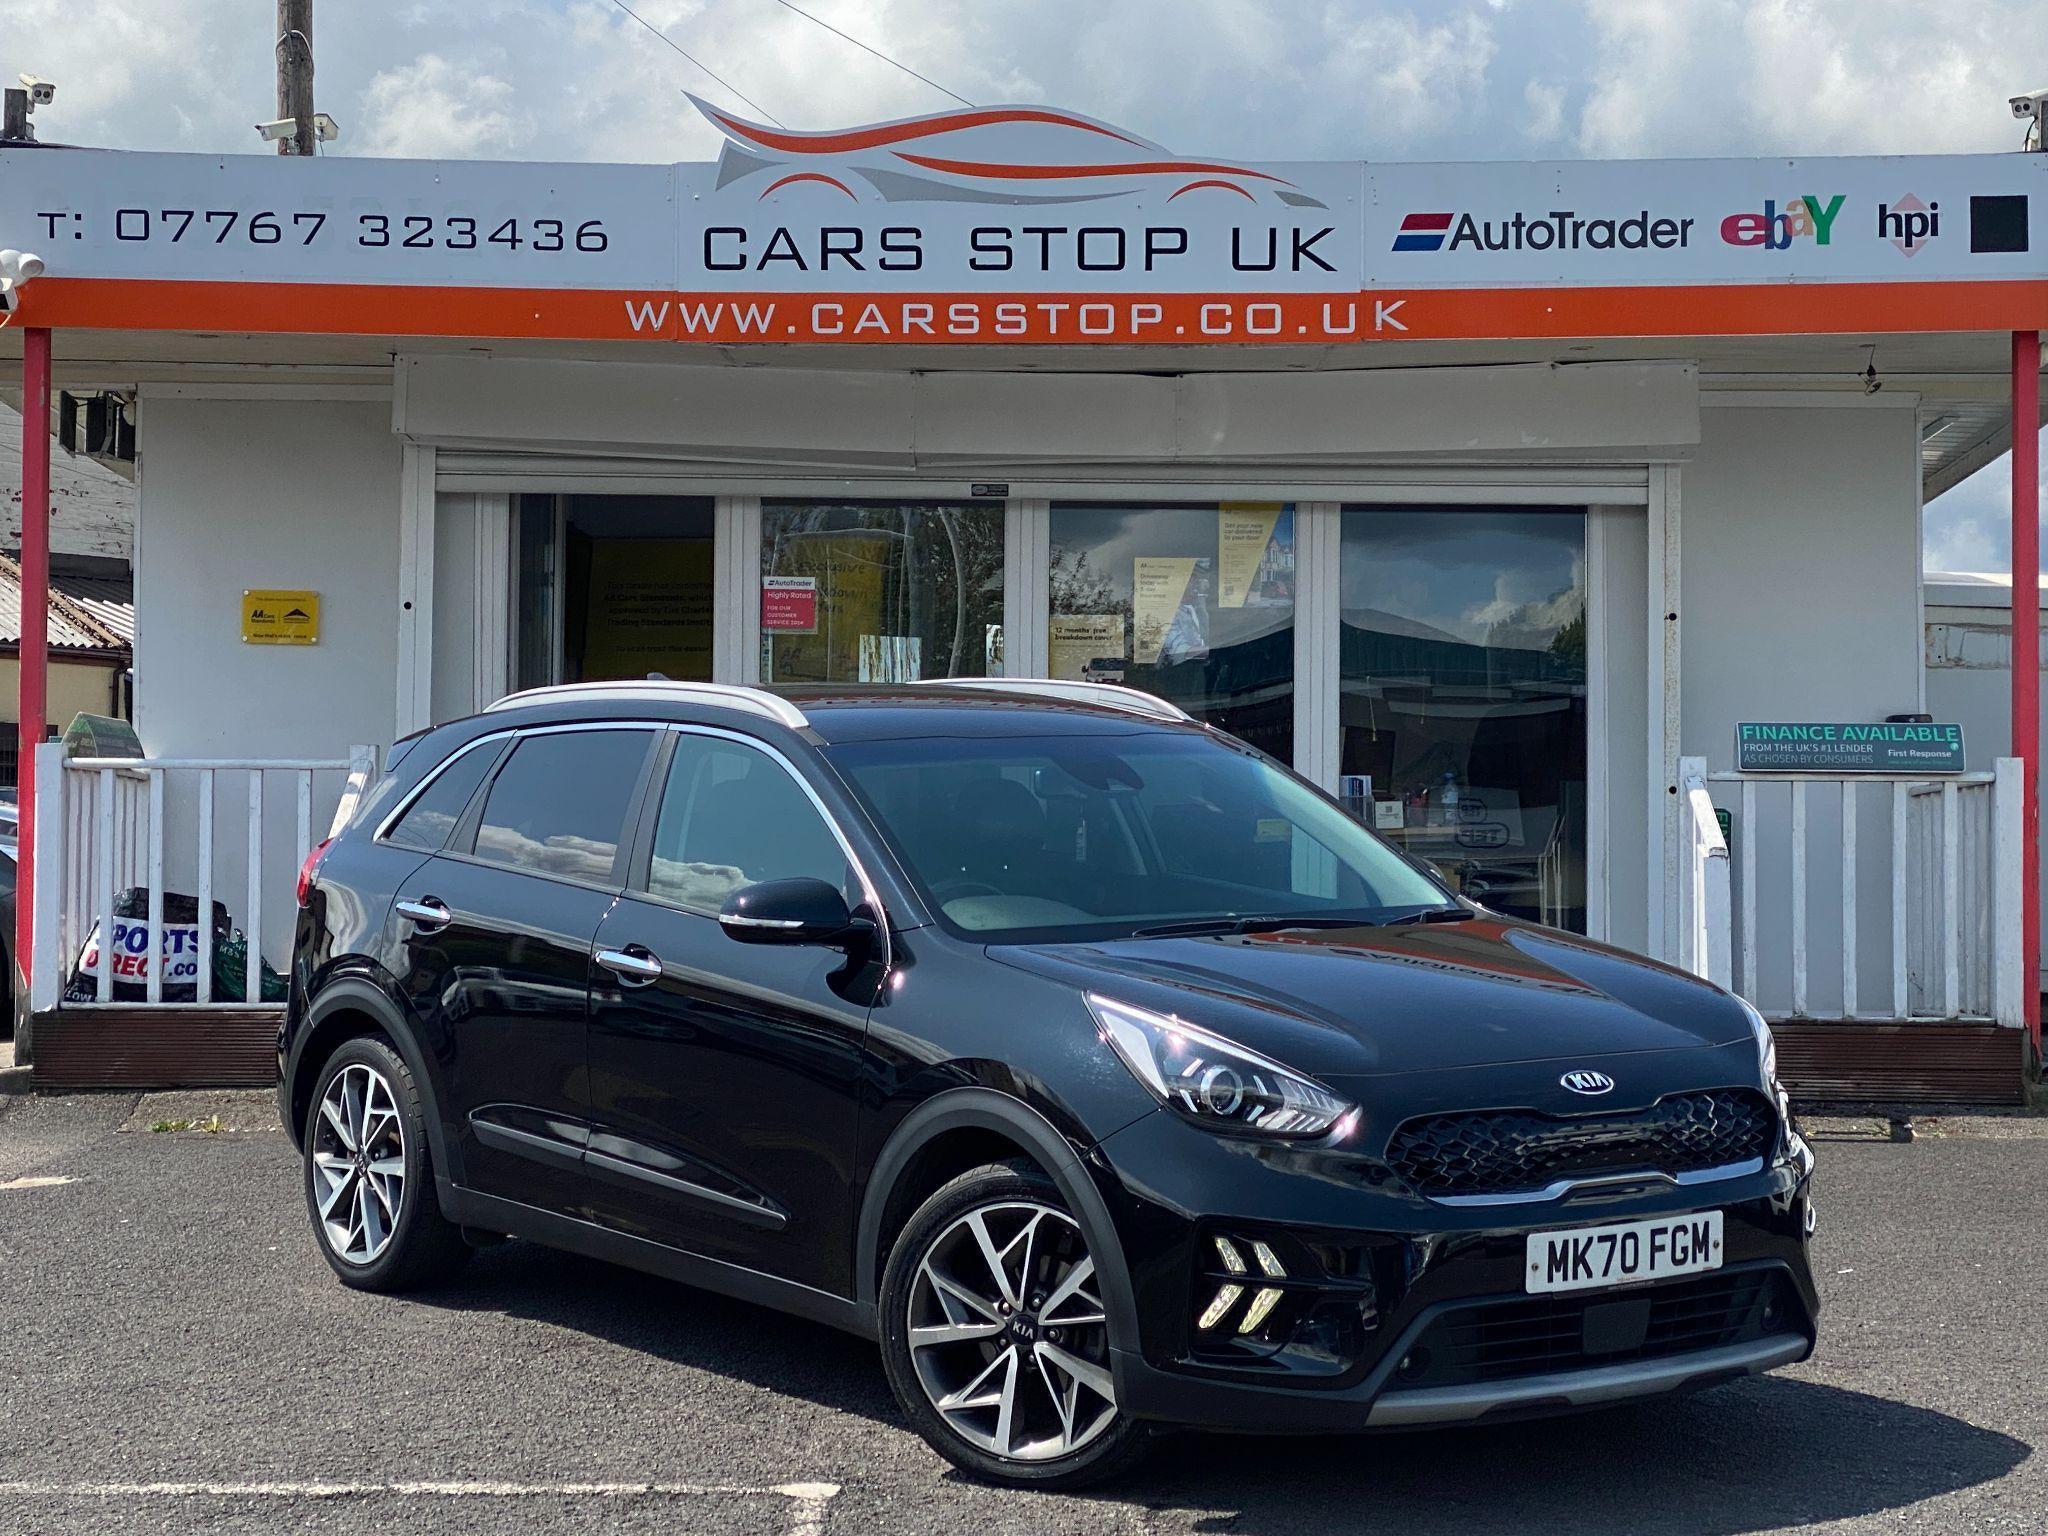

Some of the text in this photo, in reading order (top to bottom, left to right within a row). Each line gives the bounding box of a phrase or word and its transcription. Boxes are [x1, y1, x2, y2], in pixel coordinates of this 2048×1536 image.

[37, 209, 609, 253] T: 07767 323436
[1449, 211, 1695, 251] AutoTrader
[1879, 202, 1940, 248] hpi
[703, 227, 1338, 272] CARS STOP UK
[624, 299, 1409, 336] WWW.CARSSTOP.CO.UK
[767, 592, 789, 600] Highly
[1742, 725, 1959, 742] FINANCE AVAILABLE
[1743, 743, 1874, 753] FROM THE UK'S #1 LENDER
[1888, 749, 1952, 759] First Response
[1743, 753, 1874, 764] AS CHOSEN BY CONSUMERS
[1568, 1072, 1610, 1089] KIA
[1547, 1221, 1710, 1283] MK70 FGM
[1012, 1321, 1034, 1339] KIA
